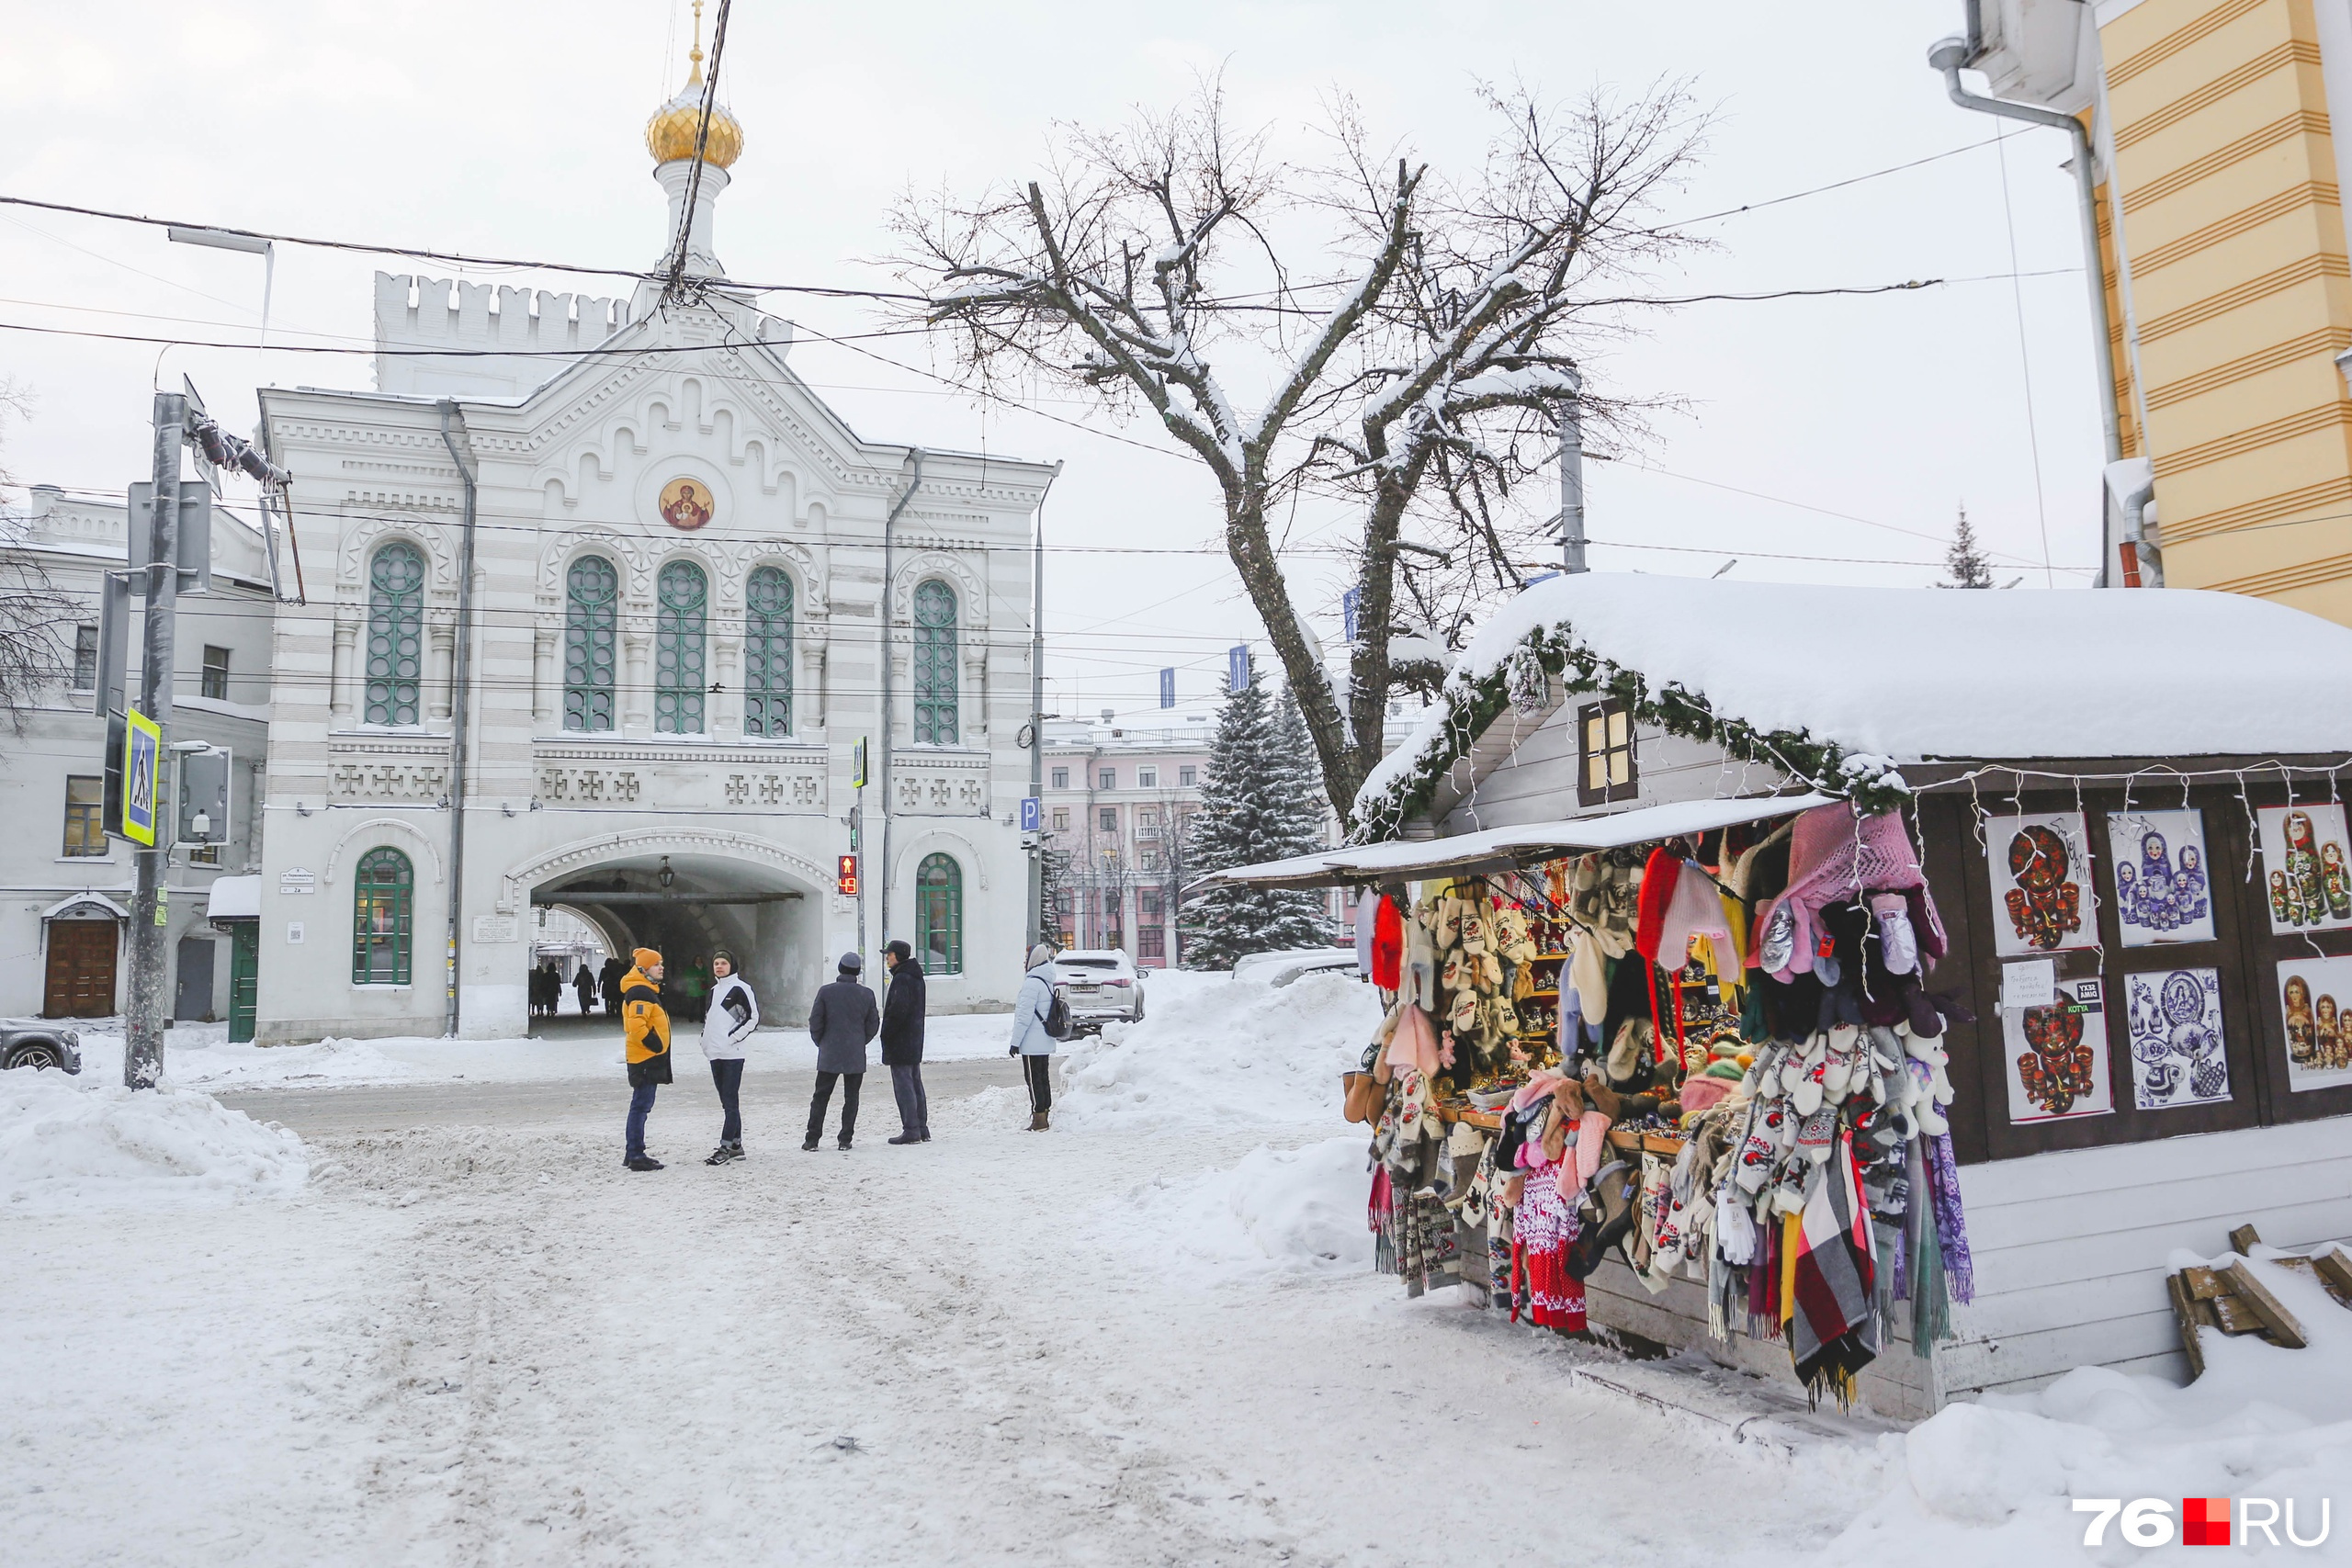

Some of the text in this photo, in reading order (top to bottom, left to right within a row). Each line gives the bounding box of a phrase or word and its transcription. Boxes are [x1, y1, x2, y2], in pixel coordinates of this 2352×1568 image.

[1025, 801, 1036, 828] P
[839, 877, 856, 894] 49
[2067, 1004, 2089, 1013] KOTYA
